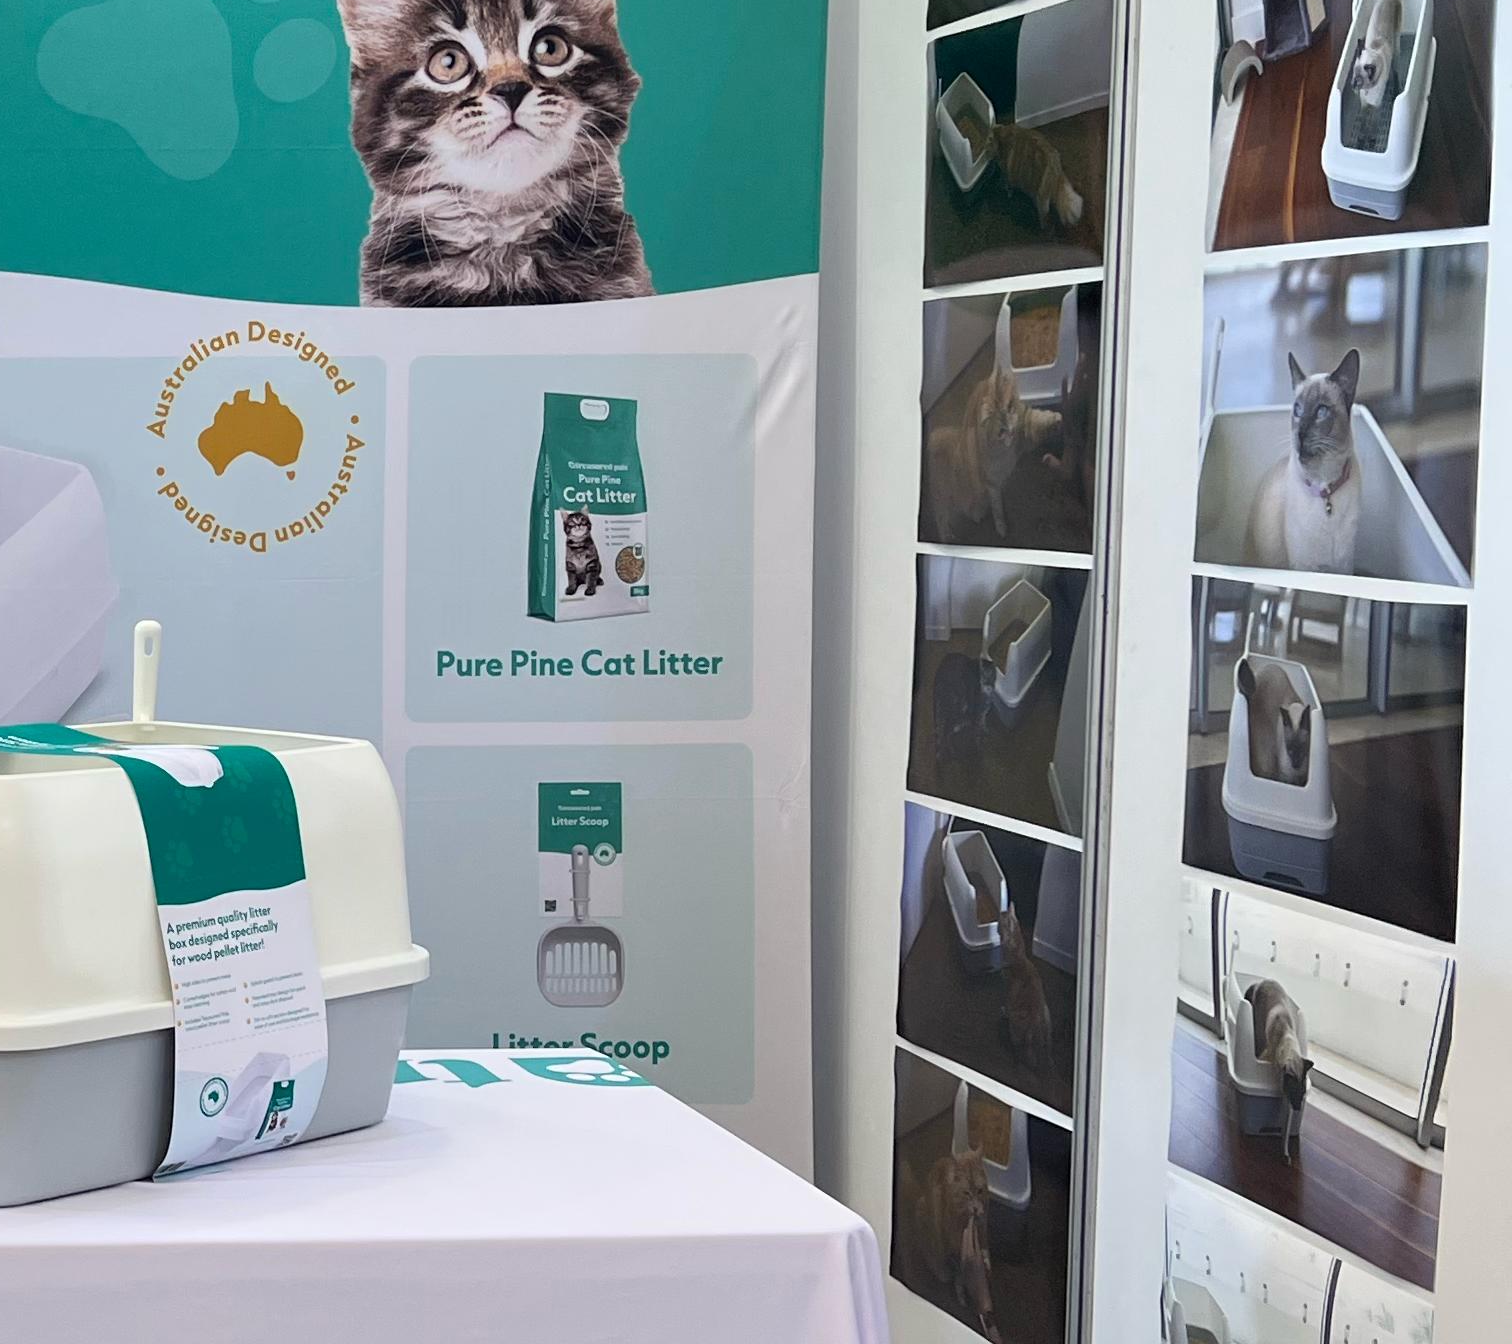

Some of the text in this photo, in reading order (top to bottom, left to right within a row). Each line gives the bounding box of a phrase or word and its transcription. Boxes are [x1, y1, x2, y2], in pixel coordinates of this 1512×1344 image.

[146, 320, 356, 439] Australian Designed
[578, 474, 601, 484] Pure
[157, 434, 366, 553] Australian Designed
[563, 486, 637, 504] Cat Litter
[437, 649, 723, 677] Pure Pine Cat Litter
[551, 816, 609, 828] Litter Scoop
[166, 906, 271, 935] A premium quality litter
[168, 919, 279, 951] box designed specifically
[171, 939, 265, 967] for wood pellet litter!
[580, 1032, 670, 1065] Scoop
